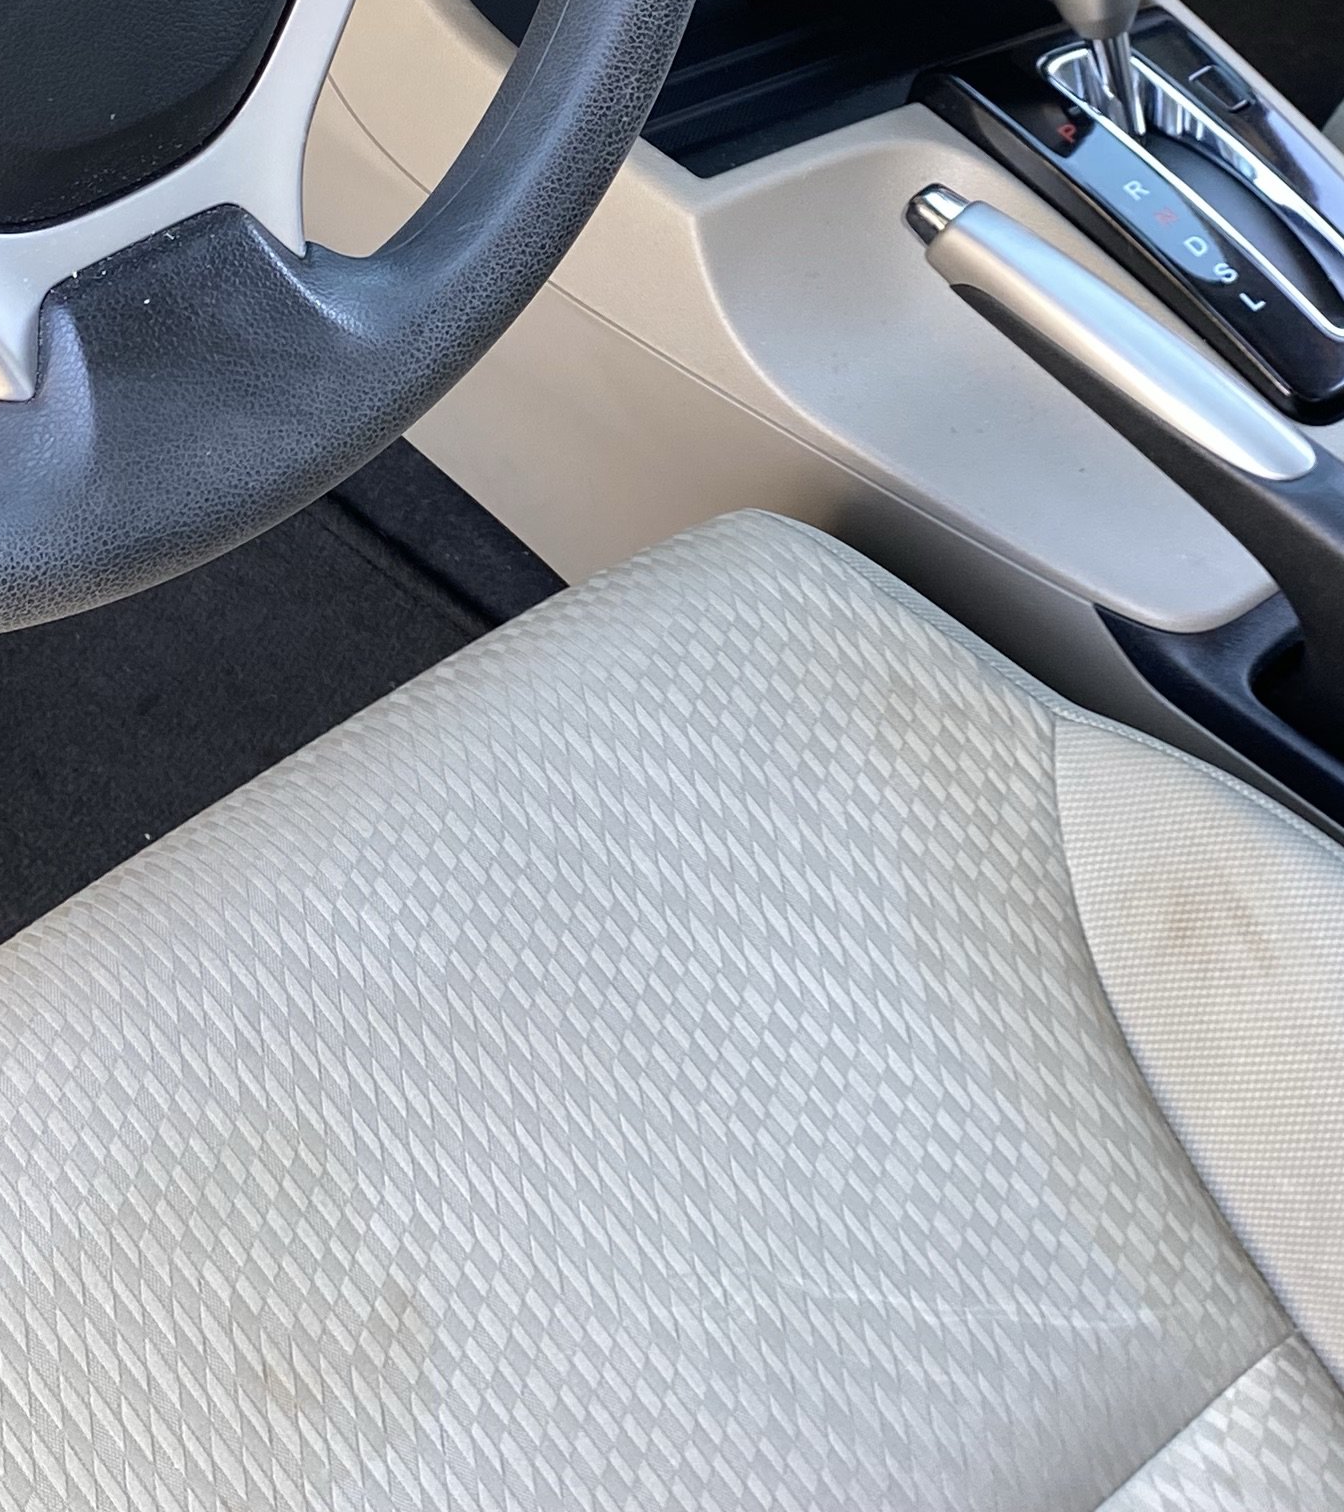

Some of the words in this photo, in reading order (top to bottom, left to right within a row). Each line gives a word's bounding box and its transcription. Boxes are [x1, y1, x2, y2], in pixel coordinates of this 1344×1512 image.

[1058, 123, 1076, 143] P
[1123, 180, 1150, 201] R
[1184, 236, 1208, 257] D
[1213, 262, 1239, 284] S
[1239, 292, 1266, 312] L
